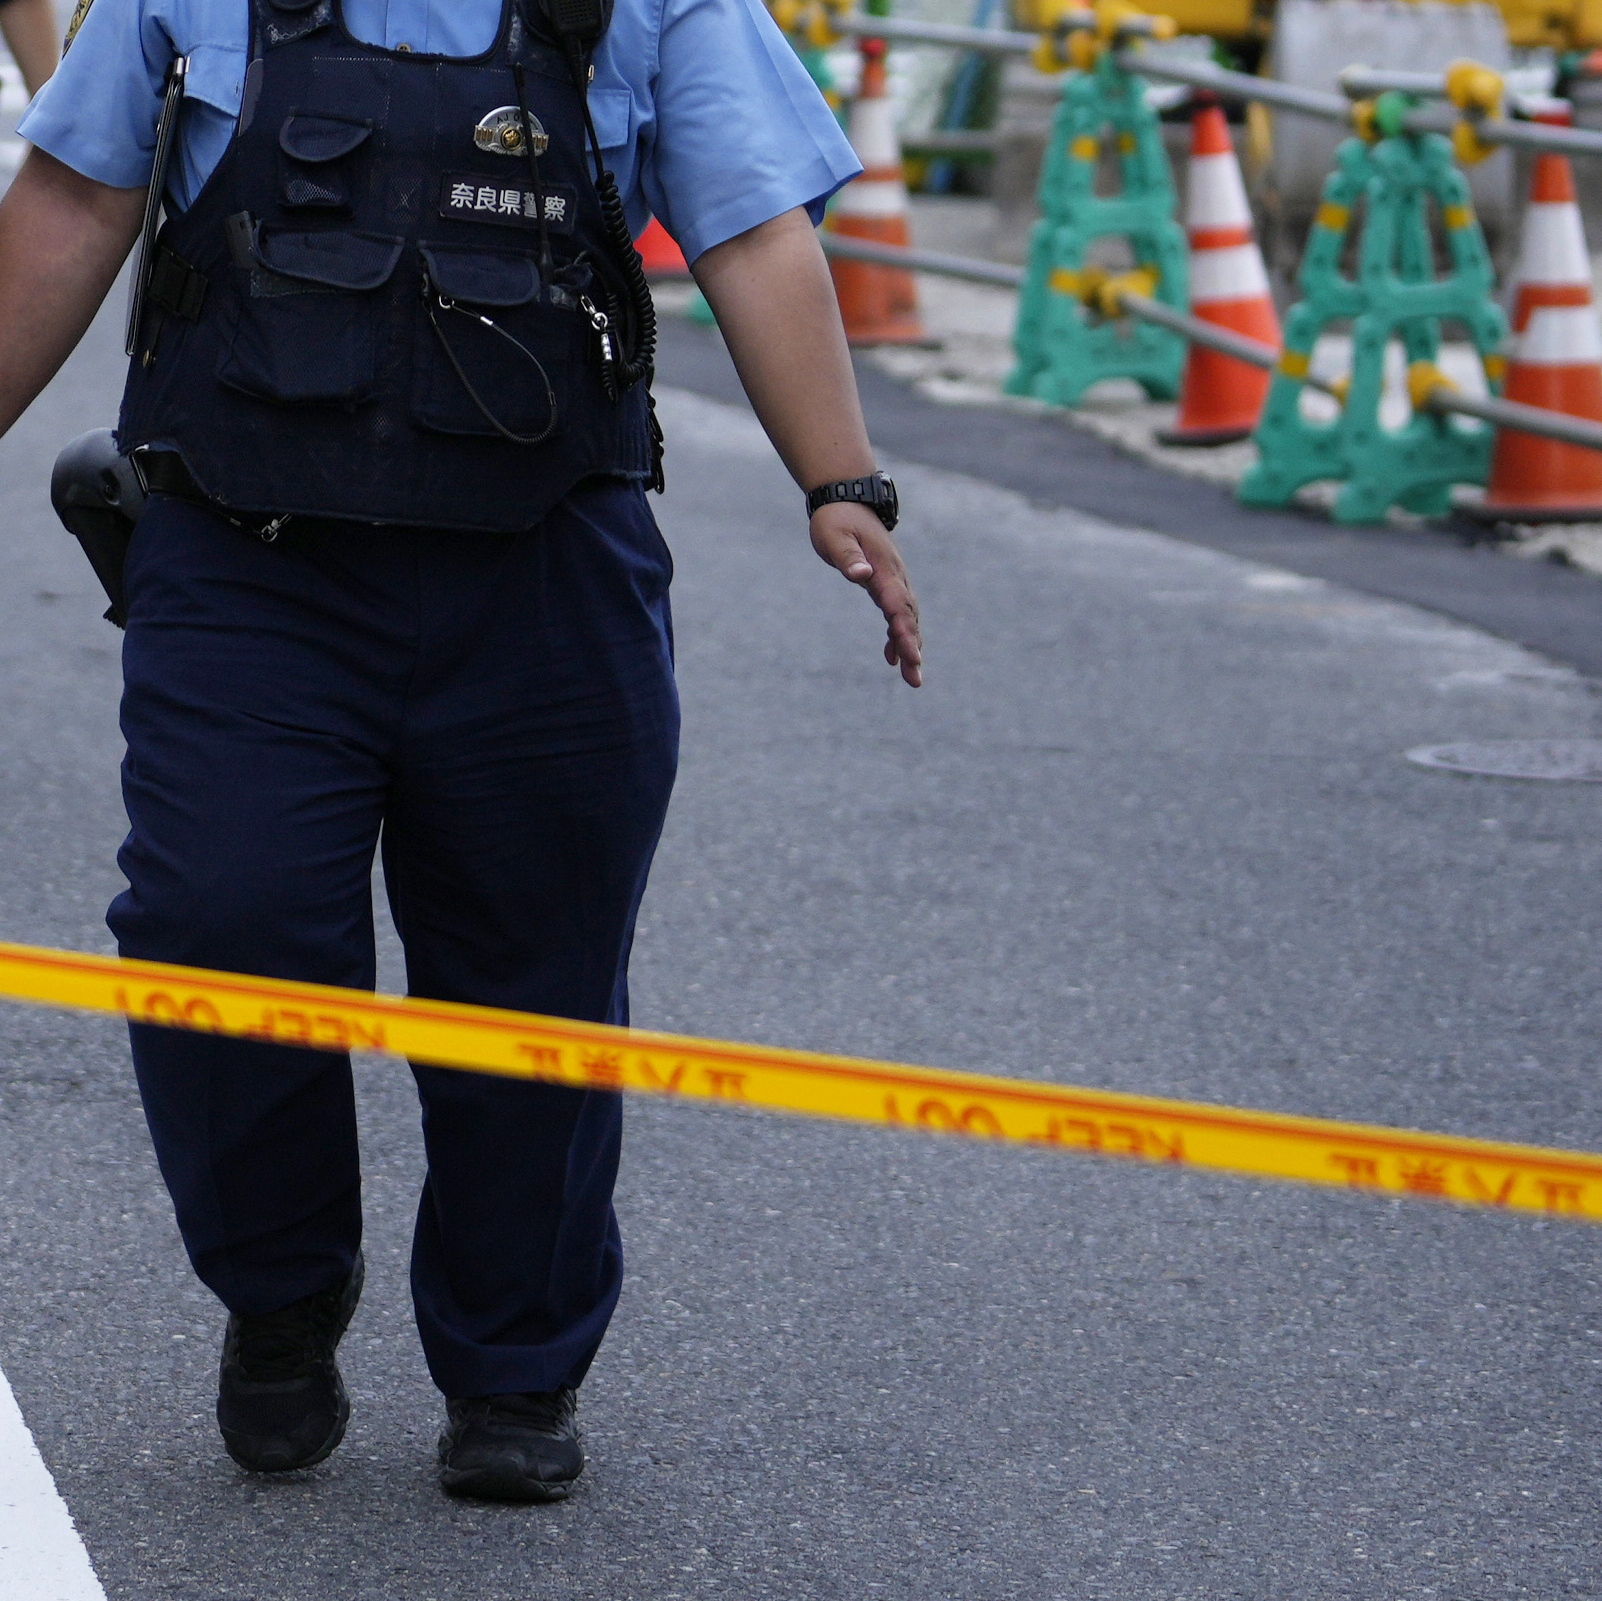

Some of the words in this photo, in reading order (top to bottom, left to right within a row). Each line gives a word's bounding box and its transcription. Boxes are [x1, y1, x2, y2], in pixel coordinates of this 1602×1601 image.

[450, 182, 566, 222] 奈良県警察
